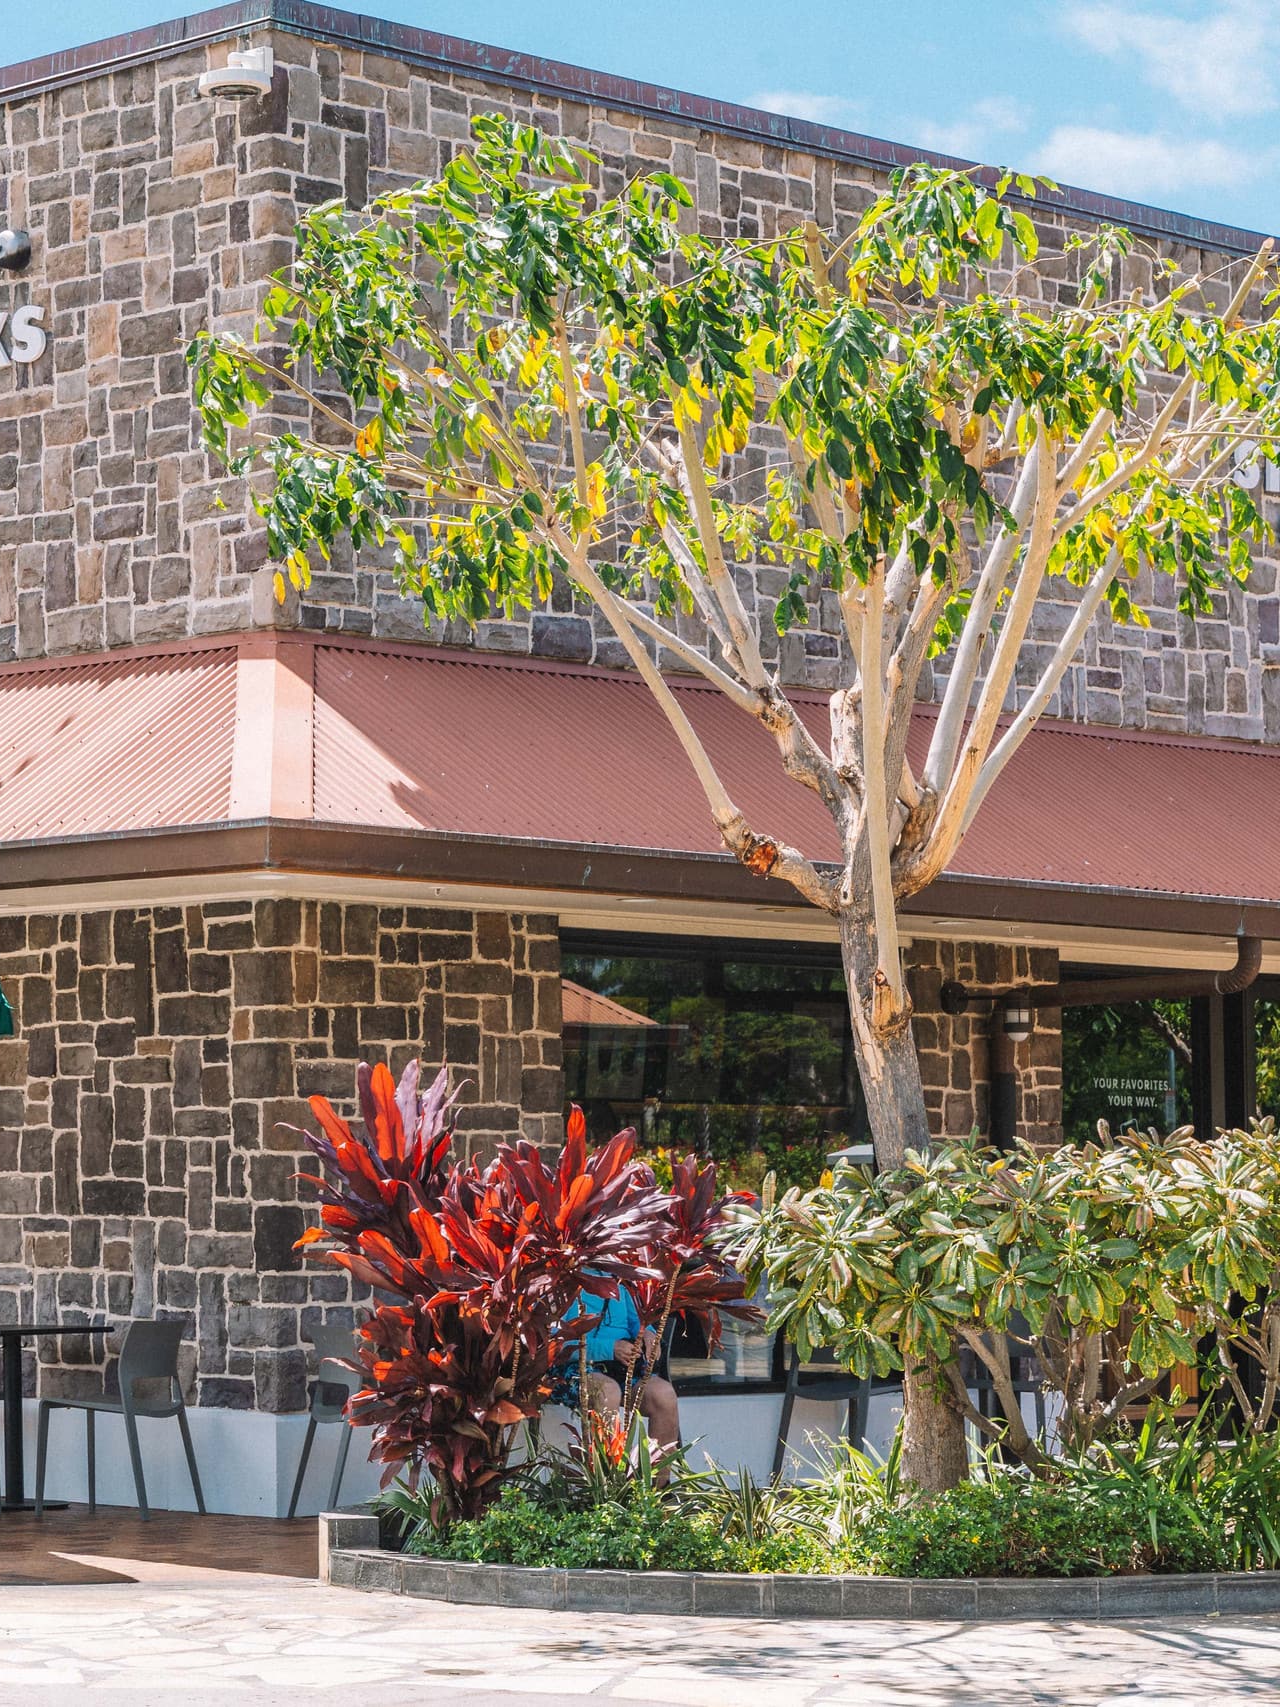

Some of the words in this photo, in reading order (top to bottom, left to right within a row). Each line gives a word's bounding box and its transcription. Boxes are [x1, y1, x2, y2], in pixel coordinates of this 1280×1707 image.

[1093, 1077, 1119, 1090] YOUR
[1120, 1078, 1172, 1092] FAVORITES.
[1108, 1095, 1133, 1107] YOUR
[1135, 1096, 1158, 1108] WAY.
